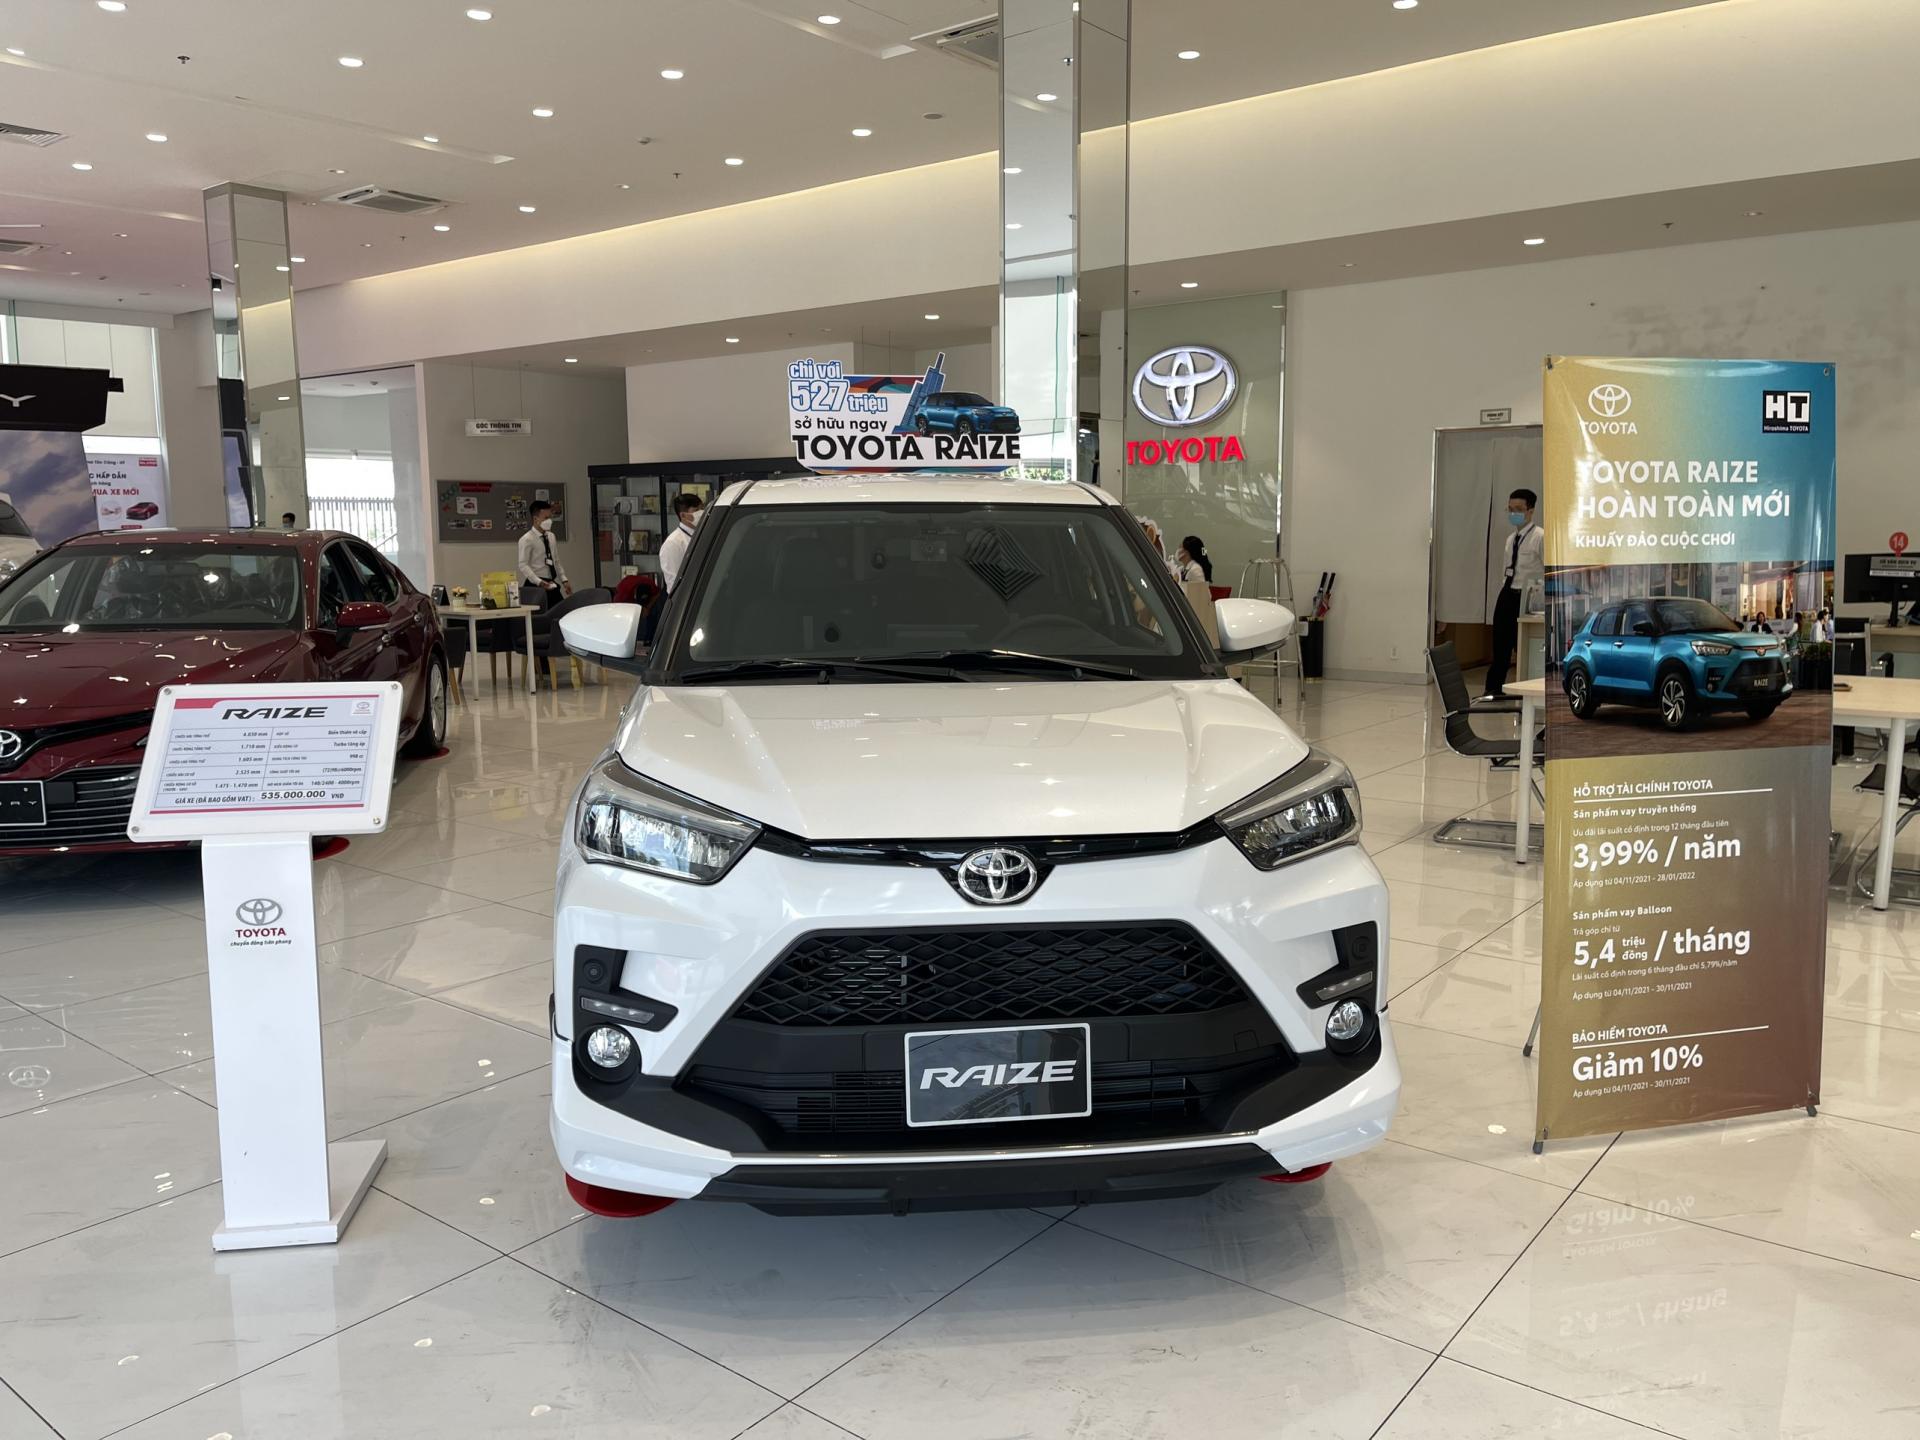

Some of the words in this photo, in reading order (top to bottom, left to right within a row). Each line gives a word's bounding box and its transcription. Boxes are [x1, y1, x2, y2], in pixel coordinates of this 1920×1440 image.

[789, 359, 813, 379] chỉ
[815, 361, 841, 379] với
[790, 379, 848, 412] 527
[847, 394, 887, 414] triệu
[1765, 394, 1809, 420] HT
[795, 416, 812, 430] sở
[817, 417, 844, 430] hữu
[850, 420, 888, 432] ngay
[1579, 422, 1638, 434] TOYOTA
[792, 434, 924, 460] TOYOTA
[935, 434, 1021, 460] RAIZE
[1126, 435, 1244, 466] TOYOTA
[1577, 460, 1680, 484] TOYOTA
[1688, 460, 1758, 483] RAIZE
[1578, 490, 1656, 519] HOÀN
[1664, 490, 1734, 518] TOÀN
[1742, 489, 1790, 517] MỚI
[1575, 530, 1624, 548] KHUẤY
[1626, 530, 1658, 547] ĐẢO
[1660, 530, 1699, 550] CUỘC
[1702, 530, 1735, 546] CHƠI
[1893, 536, 1905, 548] 14
[222, 706, 328, 720] RAIZE
[261, 790, 326, 800] 535.000.000
[1573, 782, 1590, 797] HỖ
[1593, 784, 1615, 798] TRỢ
[1617, 781, 1634, 794] TÀI
[1635, 780, 1672, 794] CHÍNH
[1672, 780, 1713, 792] TOYOTA
[1573, 808, 1590, 818] Sản
[1592, 806, 1618, 820] phẩm
[1621, 808, 1636, 818] vay
[1638, 804, 1667, 817] truyền
[1670, 803, 1696, 816] thống
[1634, 824, 1650, 835] định
[1651, 824, 1670, 833] trong
[1680, 820, 1700, 832] tháng
[1716, 819, 1729, 828] tiên
[1573, 839, 1658, 872] 3,99%
[1664, 836, 1678, 868] /
[1684, 834, 1741, 860] năm
[1573, 878, 1583, 888] Áp
[1584, 878, 1603, 888] dụng
[1605, 877, 1613, 886] từ
[1614, 874, 1650, 886] 04/11/2021
[1657, 872, 1696, 882] 28/01/2022
[1573, 910, 1590, 920] Sản
[1592, 908, 1618, 921] phẩm
[1620, 908, 1636, 918] vay
[1637, 904, 1672, 916] Balloon
[235, 927, 286, 938] TOYOTA
[1573, 927, 1584, 935] Trả
[1585, 927, 1599, 937] góp
[1601, 925, 1611, 934] chỉ
[1613, 925, 1620, 933] từ
[1574, 938, 1616, 968] 5,4
[1622, 936, 1646, 948] triệu
[1654, 930, 1668, 962] /
[1674, 926, 1750, 955] tháng
[1622, 949, 1648, 961] đồng
[1572, 972, 1582, 981] Lãi
[1584, 971, 1599, 980] suất
[1610, 968, 1626, 980] định
[1628, 968, 1646, 978] trong
[1654, 964, 1674, 975] tháng
[1689, 961, 1699, 970] chỉ
[1573, 991, 1583, 1001] Áp
[1584, 990, 1603, 1000] dụng
[1604, 989, 1612, 998] từ
[1613, 986, 1650, 997] 04/11/2021
[1656, 982, 1692, 993] 30/11/2021
[1573, 1028, 1596, 1043] BẢO
[1598, 1026, 1625, 1040] HIỂM
[1627, 1024, 1668, 1037] TOYOTA
[1573, 1051, 1644, 1082] Giảm
[1650, 1044, 1703, 1073] 10%
[920, 1060, 1077, 1090] RAIZE
[1573, 1088, 1583, 1098] Áp
[1584, 1086, 1602, 1097] dụng
[1604, 1086, 1611, 1094] từ
[1612, 1082, 1649, 1094] 04/11/2021
[1655, 1077, 1690, 1088] 30/11/2021
